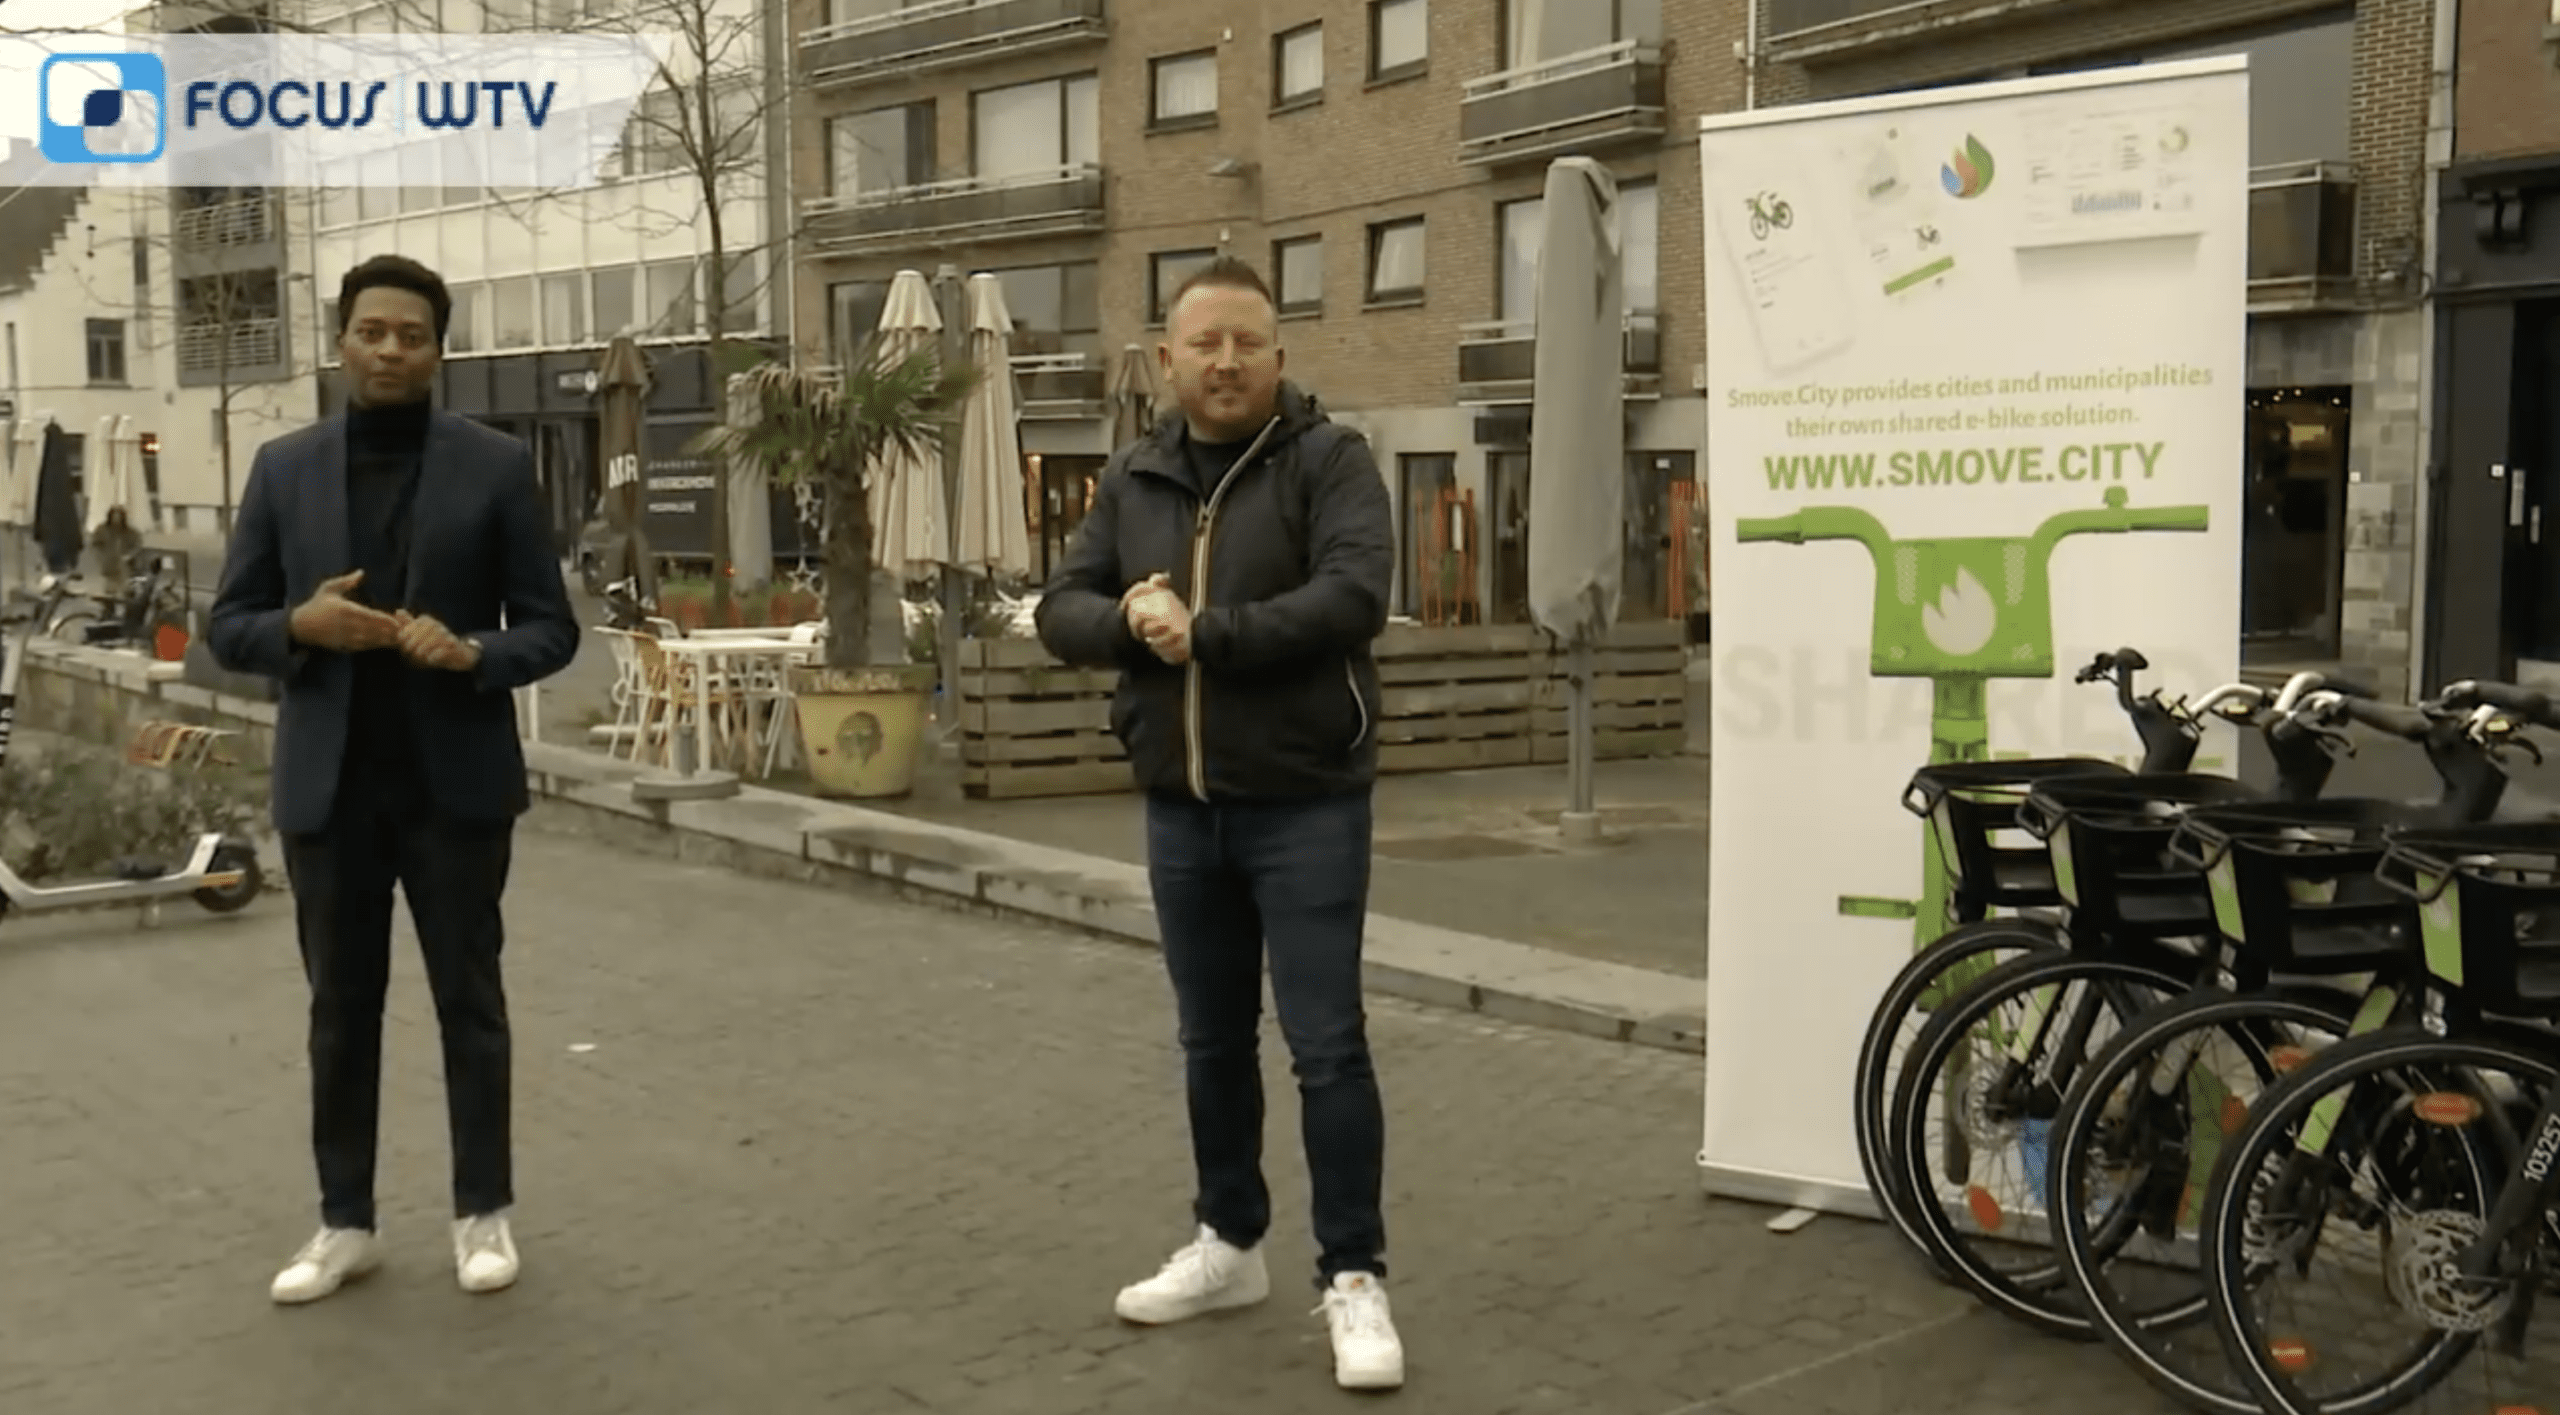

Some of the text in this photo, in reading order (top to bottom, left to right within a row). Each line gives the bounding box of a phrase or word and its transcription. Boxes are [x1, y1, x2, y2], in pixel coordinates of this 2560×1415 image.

[1727, 363, 2214, 409] Smove.City provides cities and municipalities
[1785, 403, 2141, 438] their own shared e-bike solution.
[1763, 441, 2166, 491] WWW.SMOVE.CITY
[1720, 643, 2220, 747] SHRE
